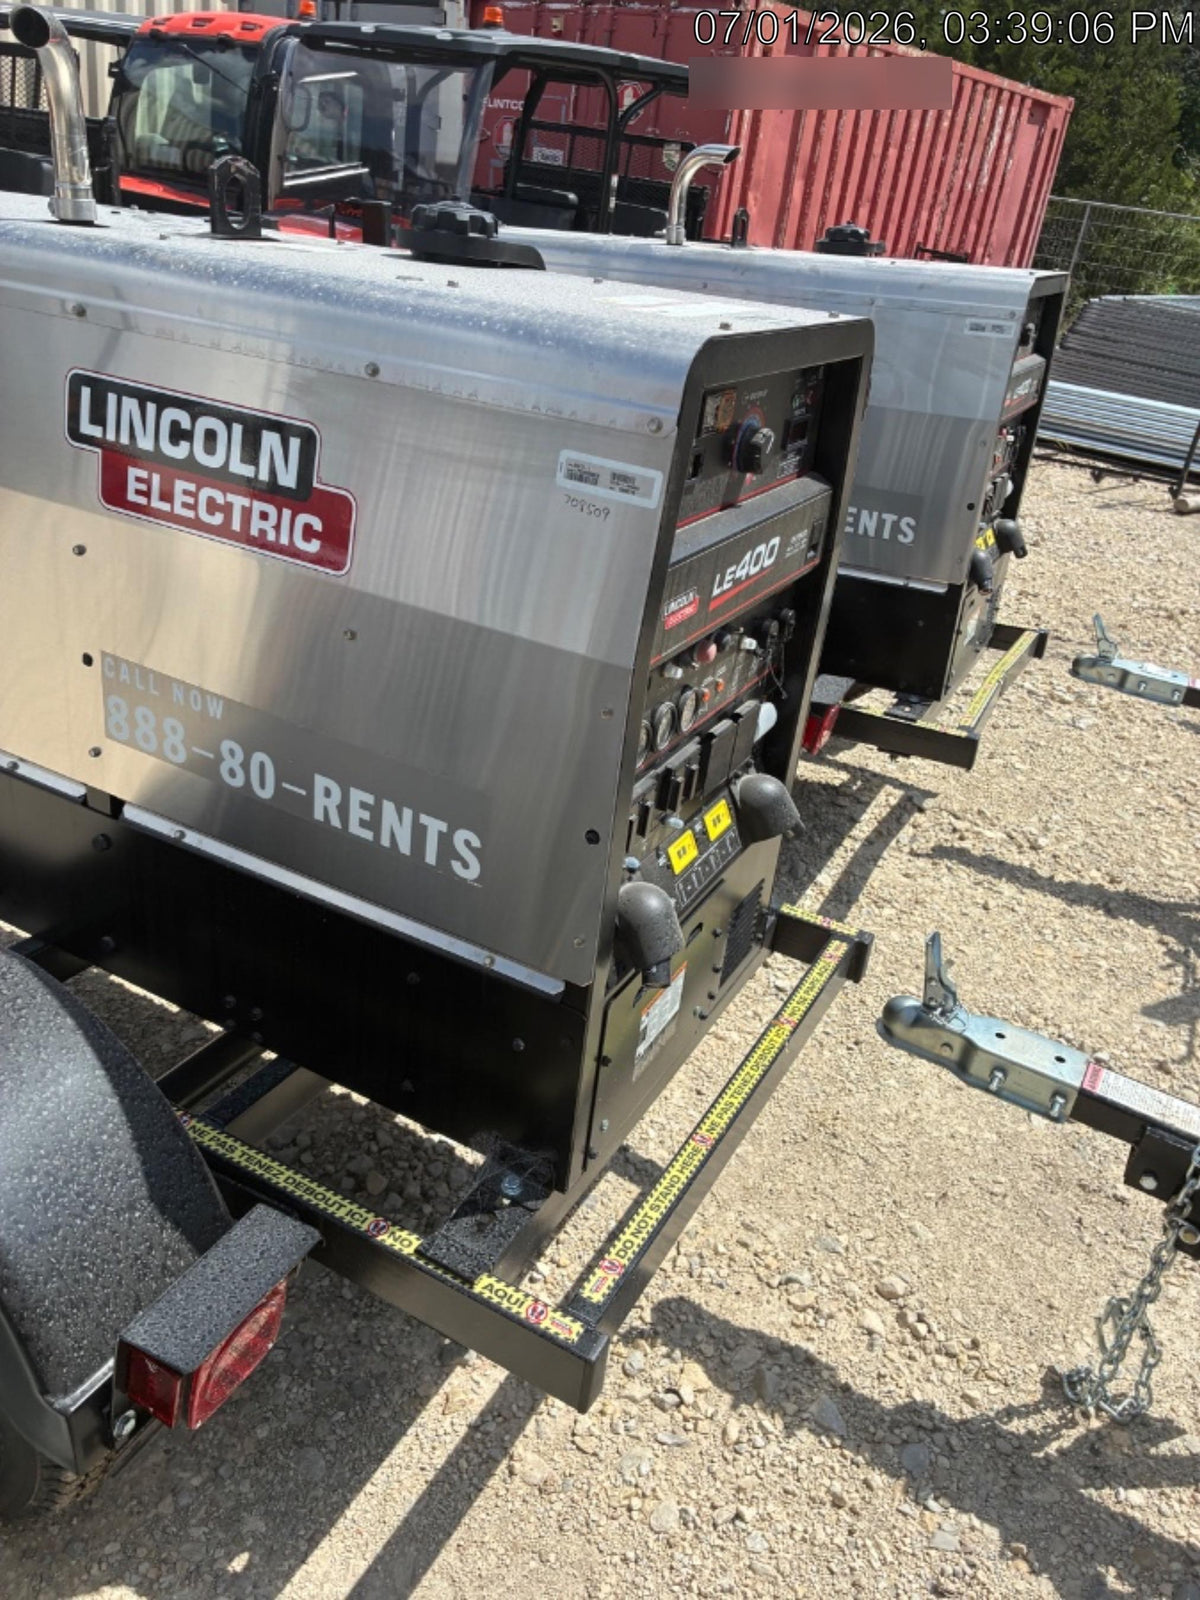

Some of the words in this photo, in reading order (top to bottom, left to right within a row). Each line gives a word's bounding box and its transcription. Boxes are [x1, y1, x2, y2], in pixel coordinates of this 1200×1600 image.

[79, 386, 300, 490] LINCOLN
[127, 466, 322, 554] ELECTRIC
[666, 590, 696, 615] LINCOLN
[712, 537, 781, 598] LE400
[103, 657, 160, 696] CALL
[173, 685, 225, 720] NOW
[189, 1123, 208, 1139] NE
[209, 1133, 238, 1156] PAS
[239, 1149, 282, 1179] TENEZ
[284, 1175, 345, 1215] DEBOUT
[345, 1208, 369, 1225] ICI
[616, 1239, 634, 1259] DO
[631, 1214, 654, 1239] NOT
[650, 1174, 681, 1212] STAND
[680, 1146, 701, 1174] HERE
[387, 1231, 413, 1249] NO
[481, 1282, 526, 1309] AQUI
